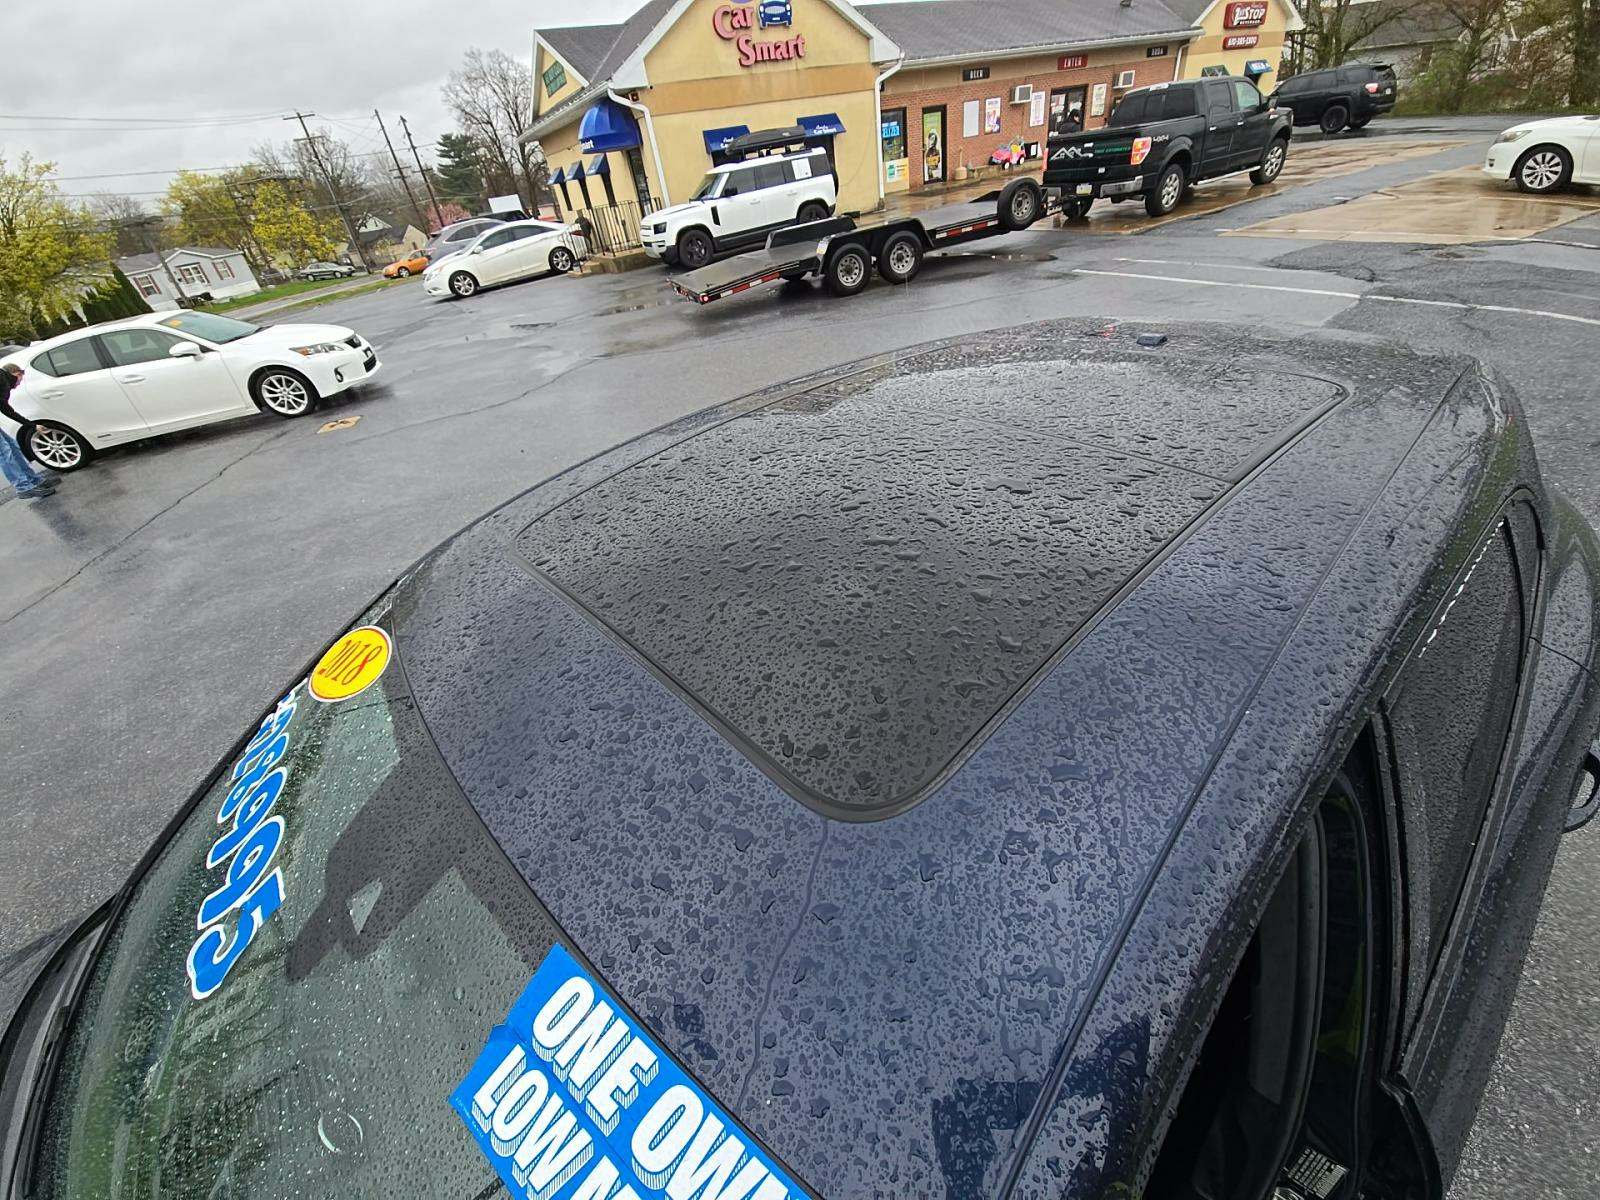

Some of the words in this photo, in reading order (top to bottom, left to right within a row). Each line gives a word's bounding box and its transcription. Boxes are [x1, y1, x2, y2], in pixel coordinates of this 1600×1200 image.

[713, 5, 754, 40] Car
[737, 34, 806, 68] Smart
[317, 639, 383, 686] 2018
[531, 976, 659, 1137] ONE
[631, 1084, 802, 1200] OW
[472, 1044, 594, 1200] LOW
